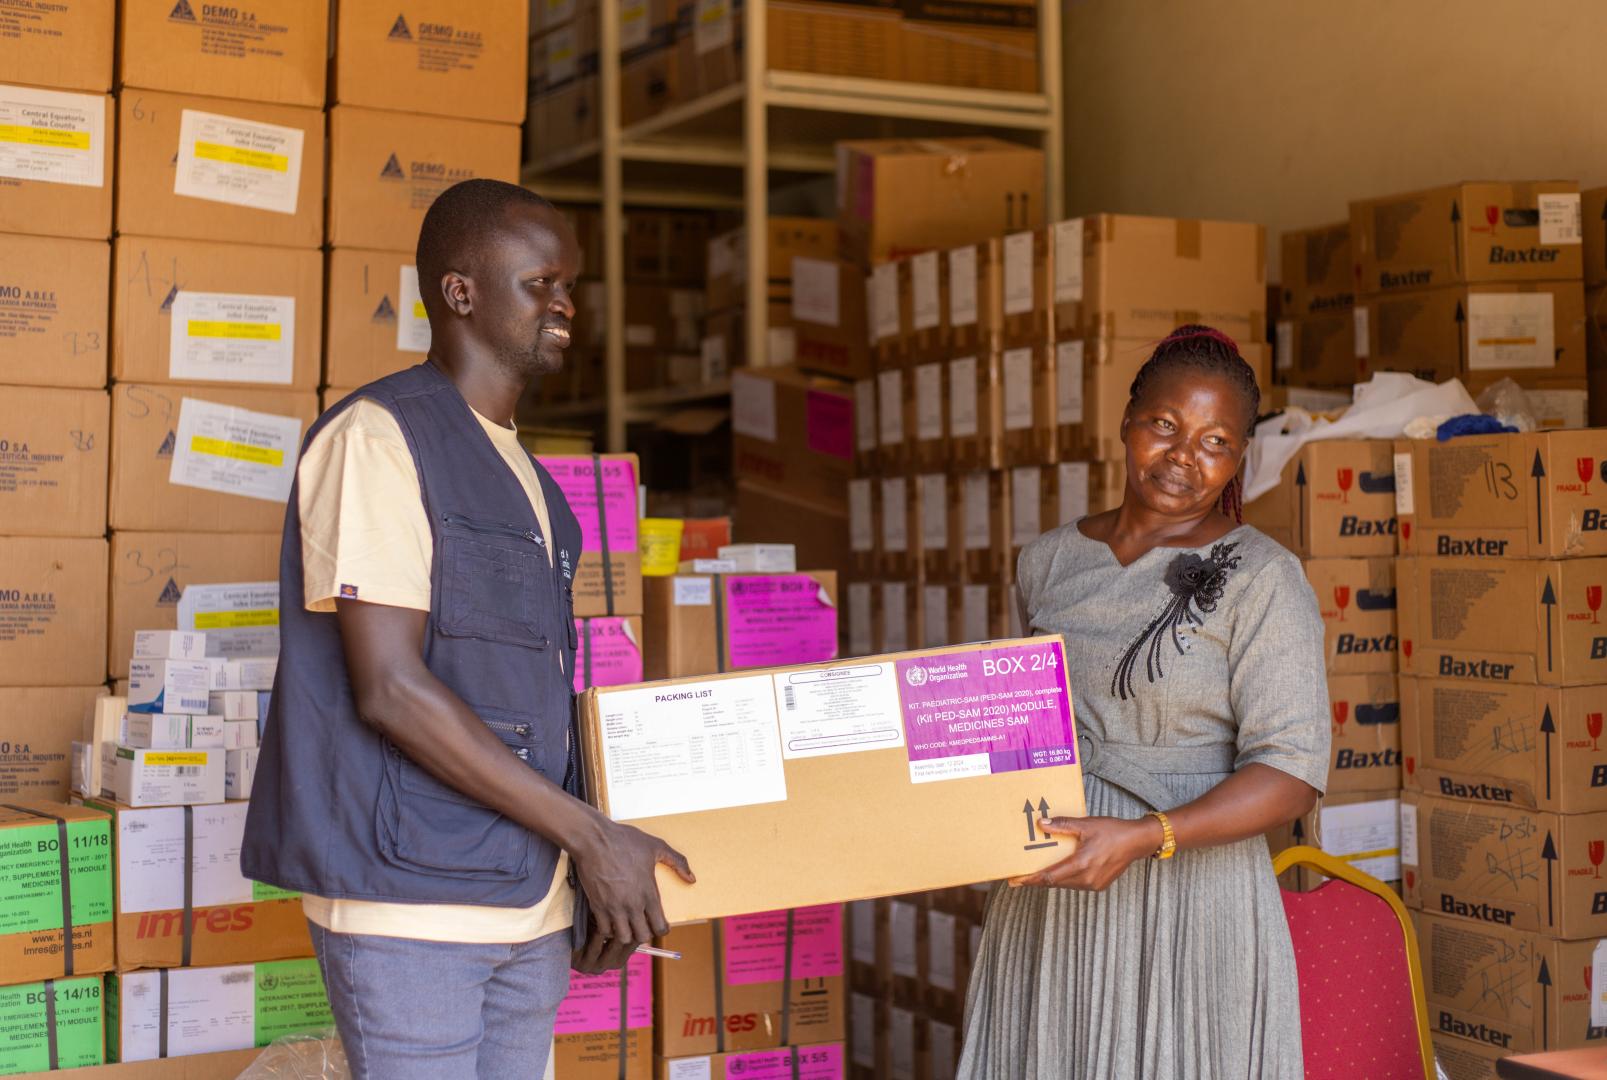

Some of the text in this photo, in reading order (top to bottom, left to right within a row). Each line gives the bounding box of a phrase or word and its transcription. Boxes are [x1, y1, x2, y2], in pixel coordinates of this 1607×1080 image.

[35, 3, 69, 13] INDUSTRY
[202, 4, 239, 20] DEMO
[419, 22, 454, 37] DEMO
[22, 109, 86, 123] Central Equatoria
[32, 118, 77, 131] Juba County
[411, 161, 446, 176] DEMO
[1488, 245, 1561, 266] Baxter
[1379, 270, 1433, 290] Baxter
[574, 465, 599, 477] BO
[1556, 483, 1582, 492] FRAGILE
[1436, 534, 1509, 557] Baxter
[1566, 613, 1593, 622] FRAGILE
[1336, 633, 1398, 655] Baxt
[928, 663, 968, 677] World Health
[983, 651, 1059, 678] BOX 2/4
[1438, 654, 1515, 681] Baxter
[930, 669, 969, 684] Organization
[655, 689, 713, 703] PACKING LIST
[922, 694, 980, 708] PAEDIATRIC-SAM
[980, 690, 1014, 702] (PED-SAM
[1035, 686, 1064, 698] complete
[916, 698, 1058, 727] (Kit PED-SAM 2020) MODULE,
[948, 715, 1031, 734] MEDICINES SAM
[913, 743, 929, 752] WHO
[1566, 740, 1593, 750] FRAGILE
[32, 753, 65, 762] INDUSTRY
[1032, 750, 1048, 760] WGT:
[1064, 747, 1072, 759] kg
[1033, 758, 1047, 768] VOL:
[1438, 776, 1514, 804] Baxter
[12, 840, 33, 852] Health
[37, 834, 108, 853] BO 11/18
[15, 859, 55, 870] EMERGENCY
[1567, 866, 1595, 877] FRAGILE
[12, 867, 77, 882] SUPPLEMENTY)
[79, 864, 107, 875] MODULE
[21, 878, 60, 890] MEDICINES
[1440, 893, 1516, 927] Baxter
[135, 906, 255, 940] imres
[32, 935, 56, 944] www.
[63, 986, 100, 1001] 14/18
[4, 1012, 43, 1022] EMERGENCY
[67, 1016, 98, 1026] MODULE
[681, 1011, 758, 1038] imes
[9, 1031, 49, 1041] MEDICINES
[1439, 1010, 1513, 1049] Baxter
[783, 1052, 829, 1067] BX 5/5
